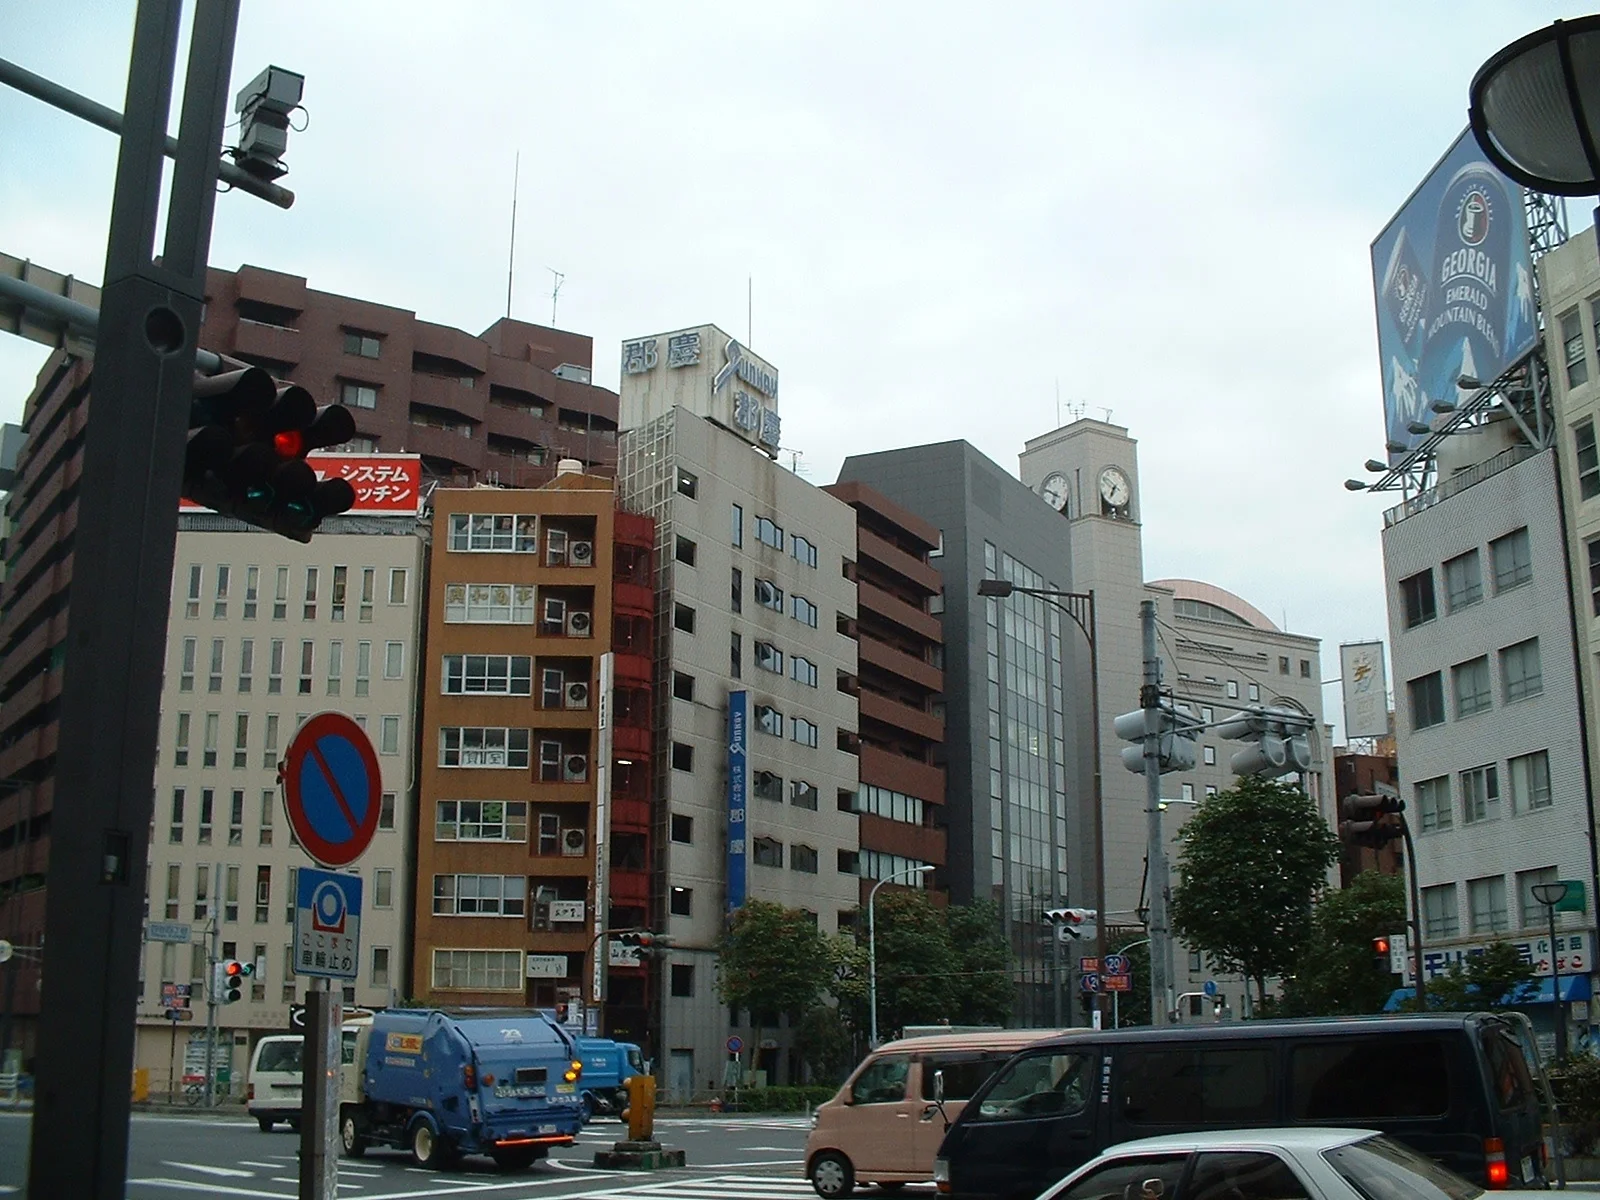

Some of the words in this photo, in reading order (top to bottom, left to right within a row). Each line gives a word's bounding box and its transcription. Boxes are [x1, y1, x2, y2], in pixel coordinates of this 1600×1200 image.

[1441, 248, 1497, 293] GEORGIA
[1446, 285, 1488, 311] EMERALD
[340, 464, 410, 484] システム
[357, 485, 411, 503] ッチン
[302, 933, 353, 951] ここまで
[302, 951, 352, 971] 車輪止め
[1108, 958, 1119, 969] 20
